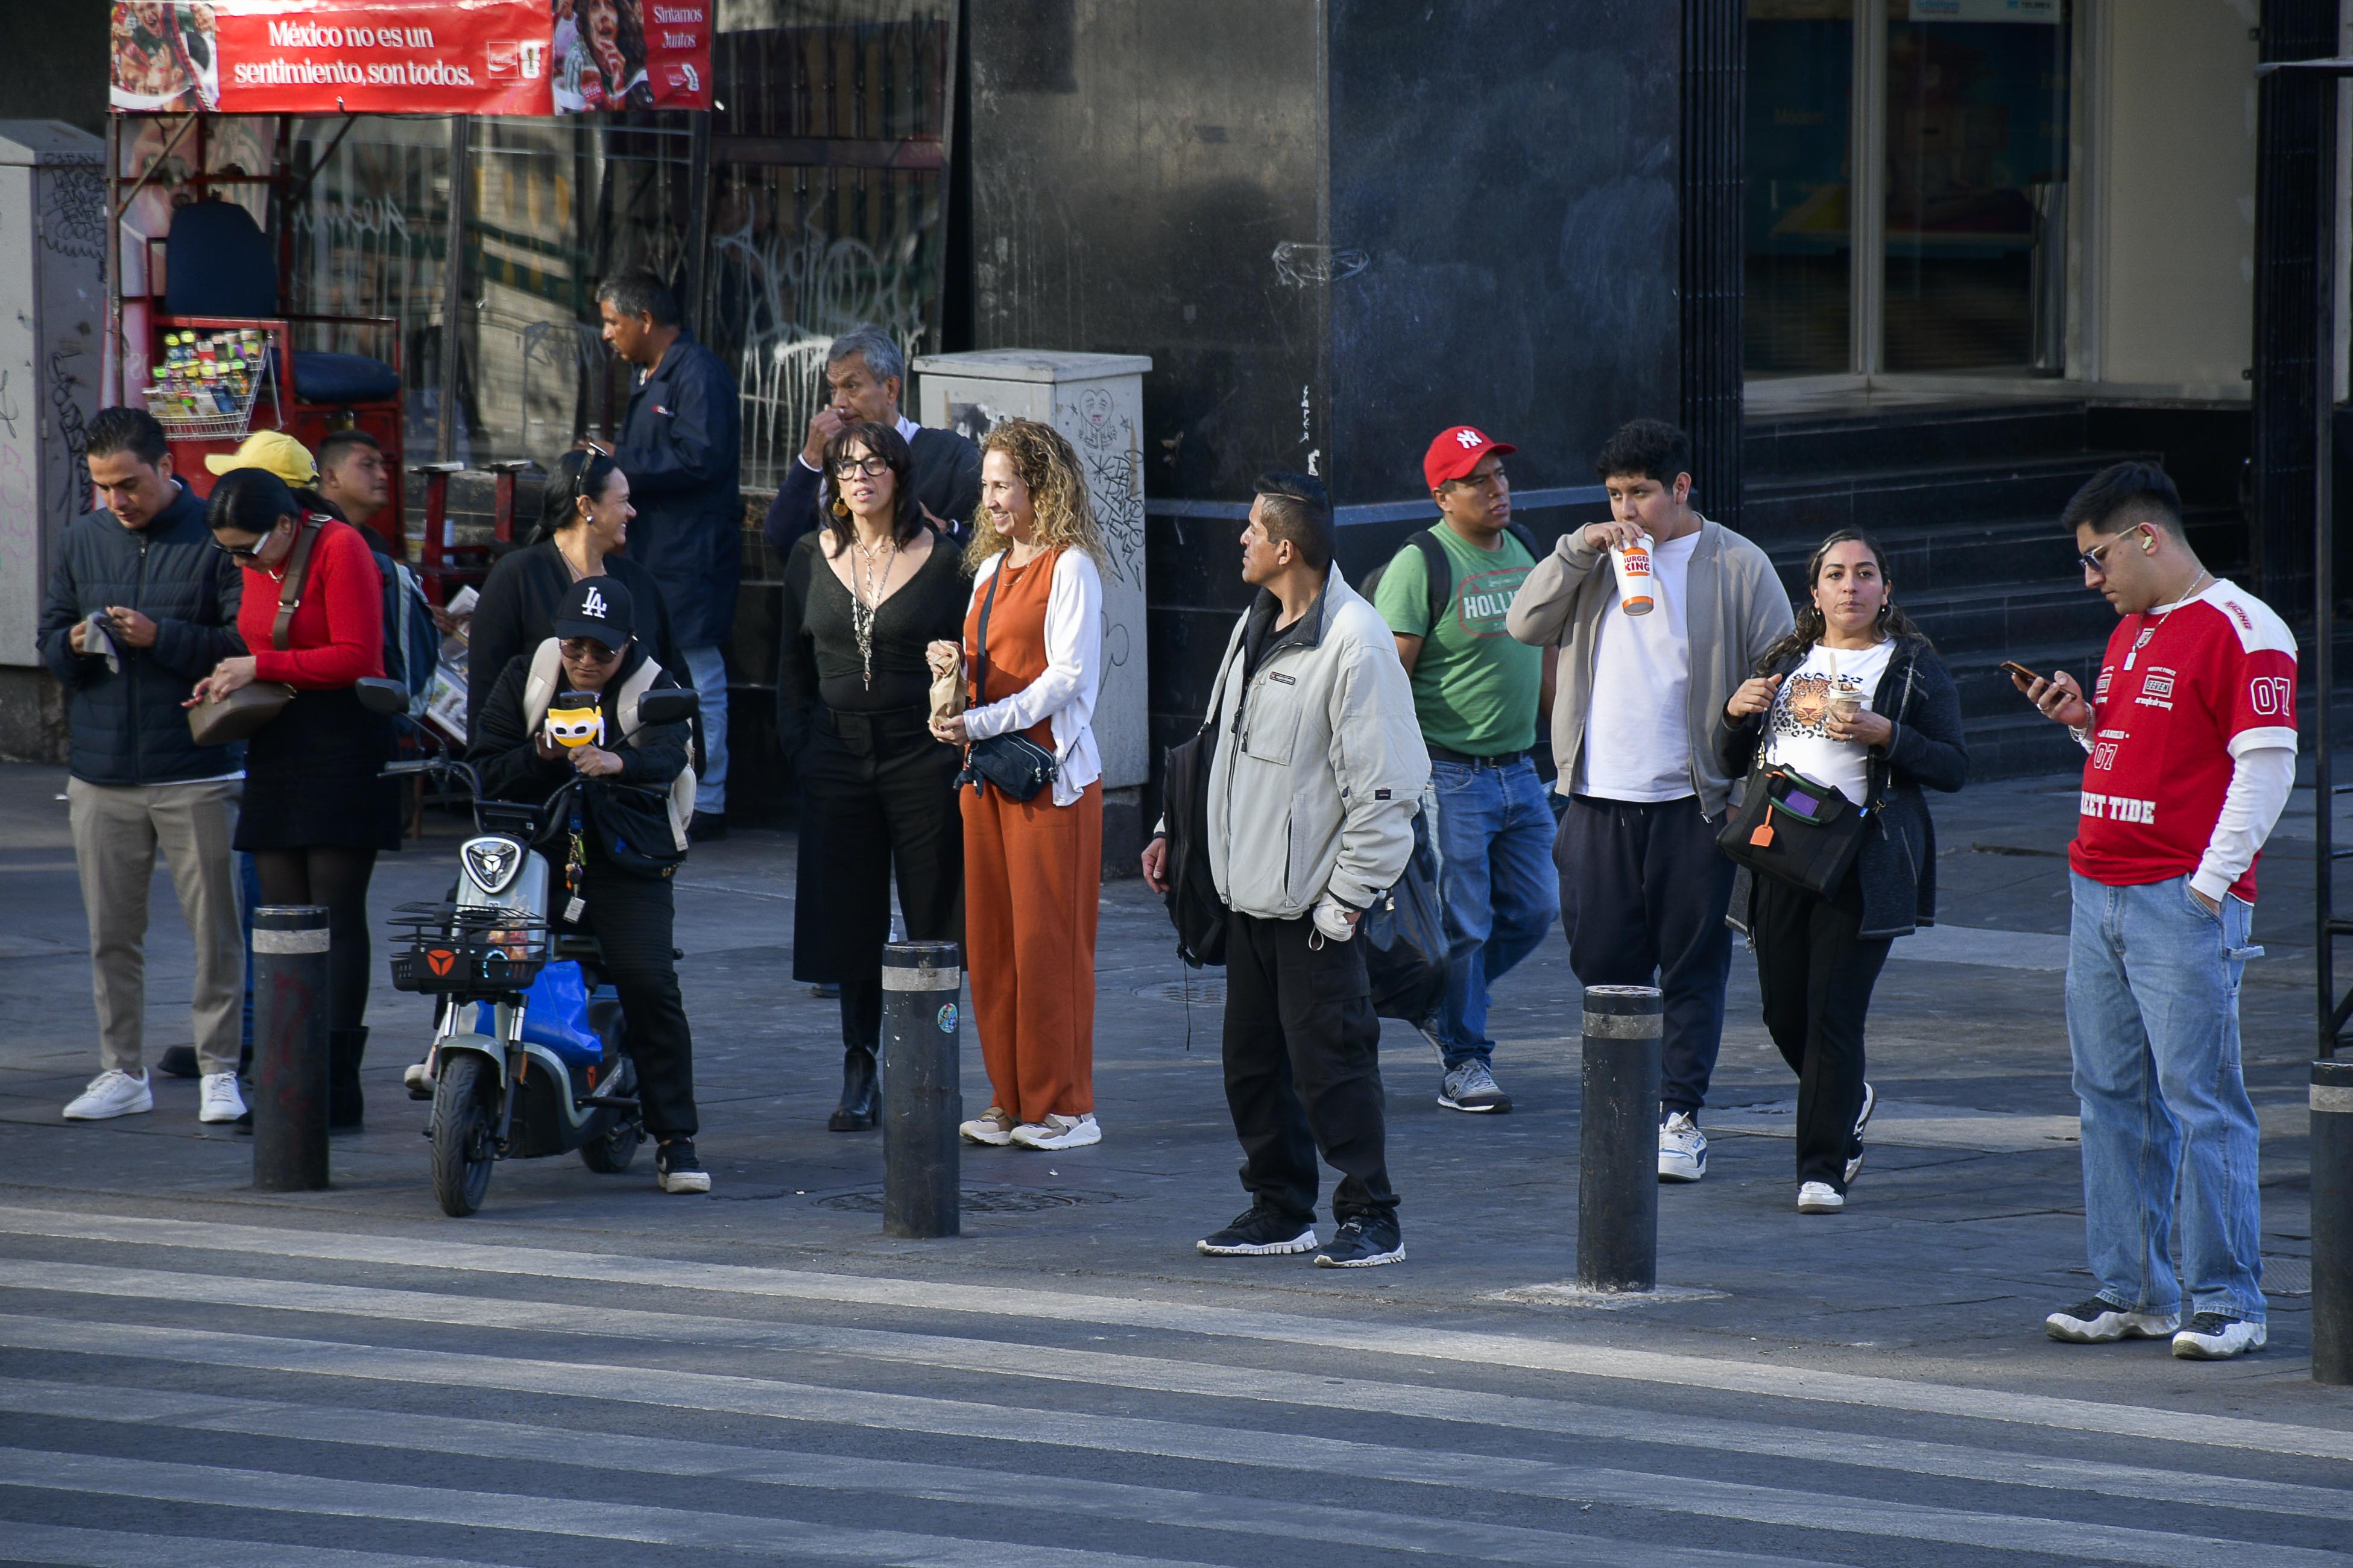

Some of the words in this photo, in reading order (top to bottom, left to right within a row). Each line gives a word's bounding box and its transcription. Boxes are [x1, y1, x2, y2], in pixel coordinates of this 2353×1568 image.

[654, 5, 703, 24] Sintamos
[268, 20, 343, 48] México
[345, 26, 374, 48] no
[377, 27, 402, 48] es
[405, 27, 435, 48] un
[233, 57, 367, 87] sentimiento,
[368, 63, 407, 86] son
[408, 58, 475, 87] todos.
[1456, 429, 1483, 449] NY
[1625, 561, 1650, 571] KING
[581, 586, 608, 619] LA
[2223, 600, 2253, 631] RACING
[2146, 680, 2168, 691] SEVEN
[2250, 676, 2291, 717] 07
[2094, 741, 2118, 771] 07
[2108, 796, 2156, 826] TIDE
